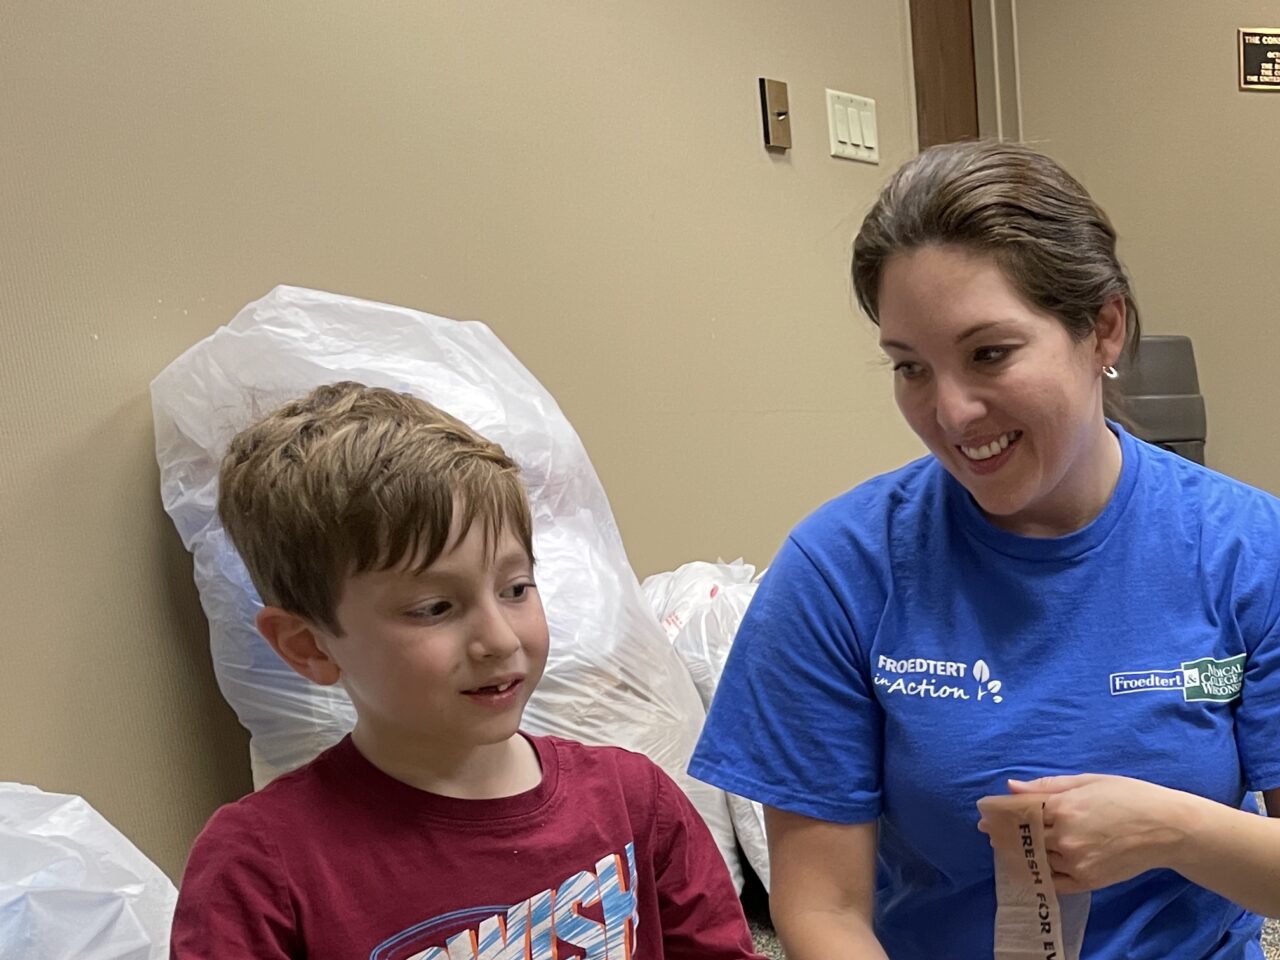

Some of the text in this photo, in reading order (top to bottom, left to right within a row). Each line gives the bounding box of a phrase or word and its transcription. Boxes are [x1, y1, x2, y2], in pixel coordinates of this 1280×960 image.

[1245, 36, 1260, 44] THE
[878, 655, 967, 678] FROEDTERT
[887, 678, 970, 699] Action
[1114, 674, 1182, 690] Froedtert
[1019, 824, 1043, 885] FRESH
[1036, 892, 1052, 935] FOR
